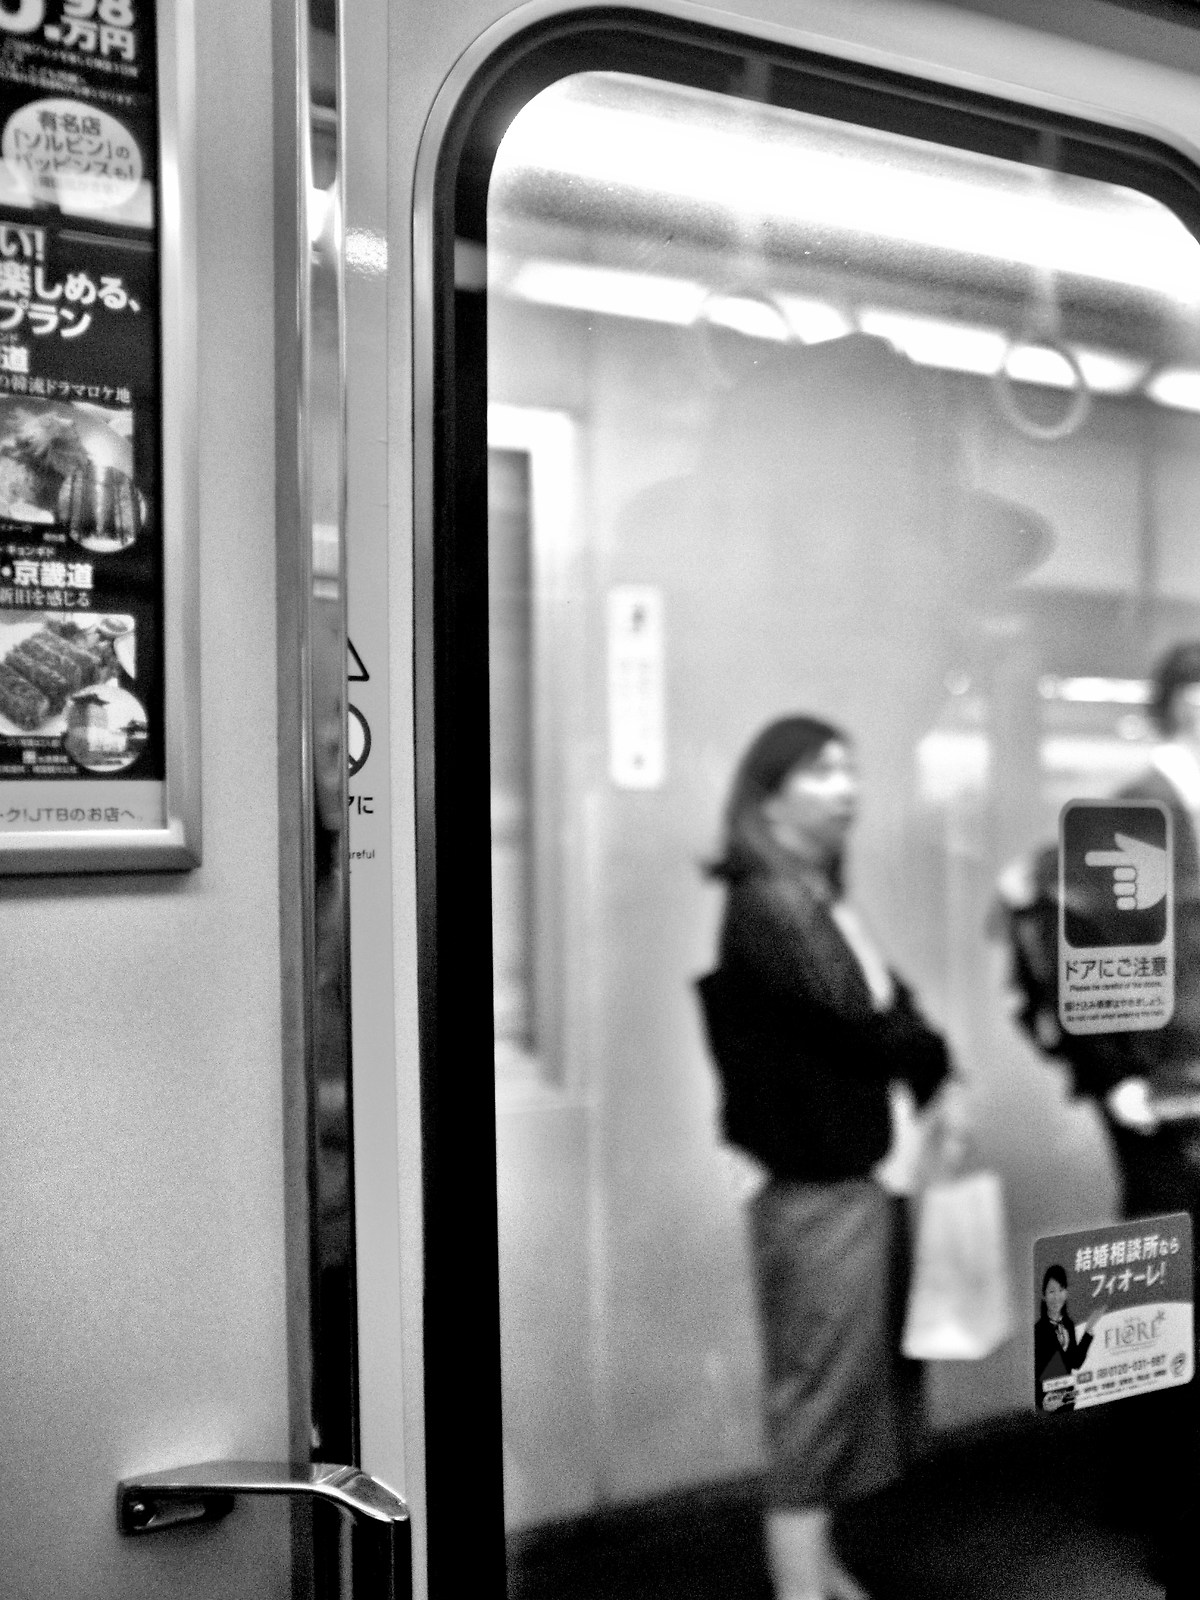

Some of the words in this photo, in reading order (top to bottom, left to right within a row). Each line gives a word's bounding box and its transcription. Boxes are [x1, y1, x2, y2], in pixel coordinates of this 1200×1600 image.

[61, 15, 136, 61] 万円
[1065, 957, 1167, 981] ドアにご注意
[1074, 1233, 1181, 1273] 結婚相談所なら
[1091, 1261, 1167, 1298] フィオーレ!
